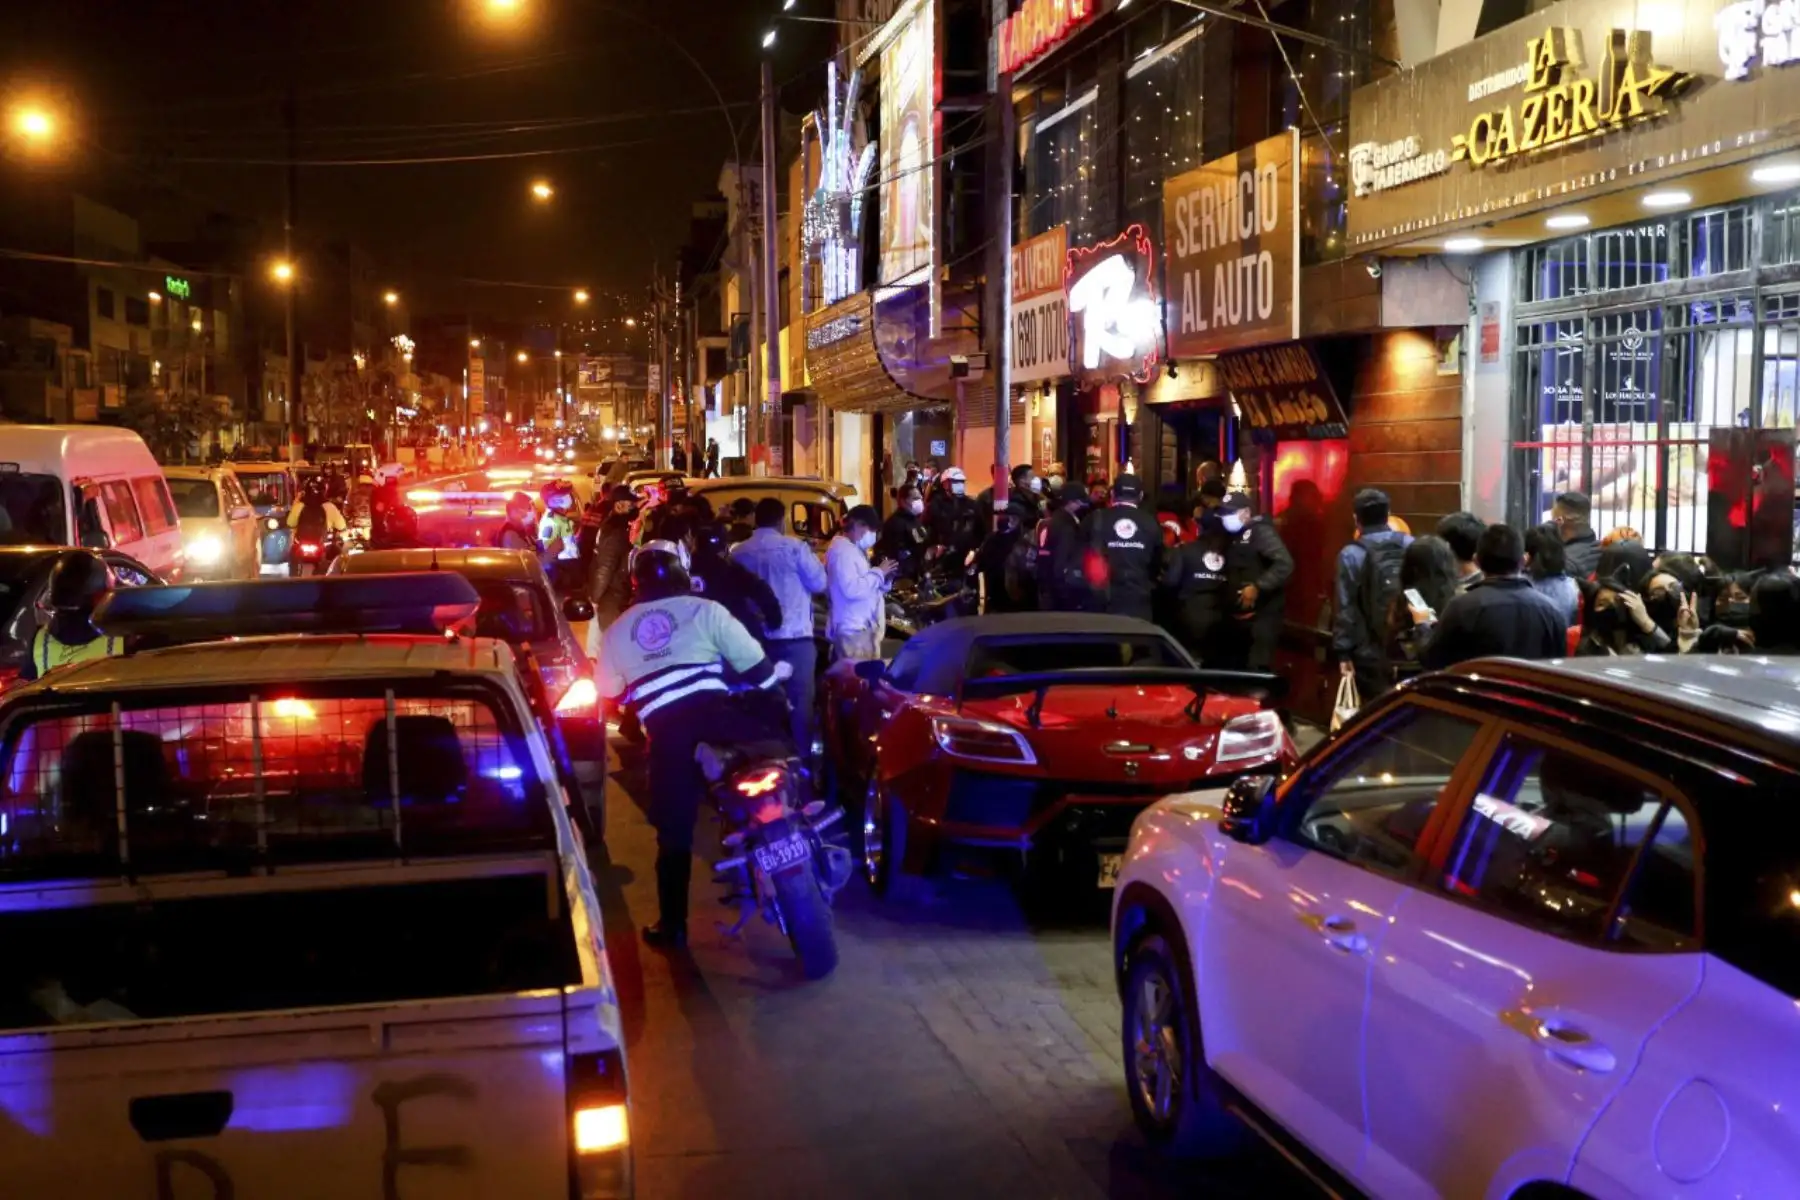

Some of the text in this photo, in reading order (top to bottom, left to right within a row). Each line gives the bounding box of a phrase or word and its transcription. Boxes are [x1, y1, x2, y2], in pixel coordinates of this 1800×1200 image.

[1523, 26, 1558, 93] LA
[1373, 135, 1417, 169] GRUPO
[1373, 149, 1446, 192] TABERNERO
[1628, 160, 1645, 176] ES
[1175, 161, 1278, 258] SERVICIO
[1011, 234, 1060, 295] ELIVERY
[1182, 250, 1273, 334] AL AUTO
[1018, 307, 1037, 369] 680
[1039, 298, 1067, 364] 7070
